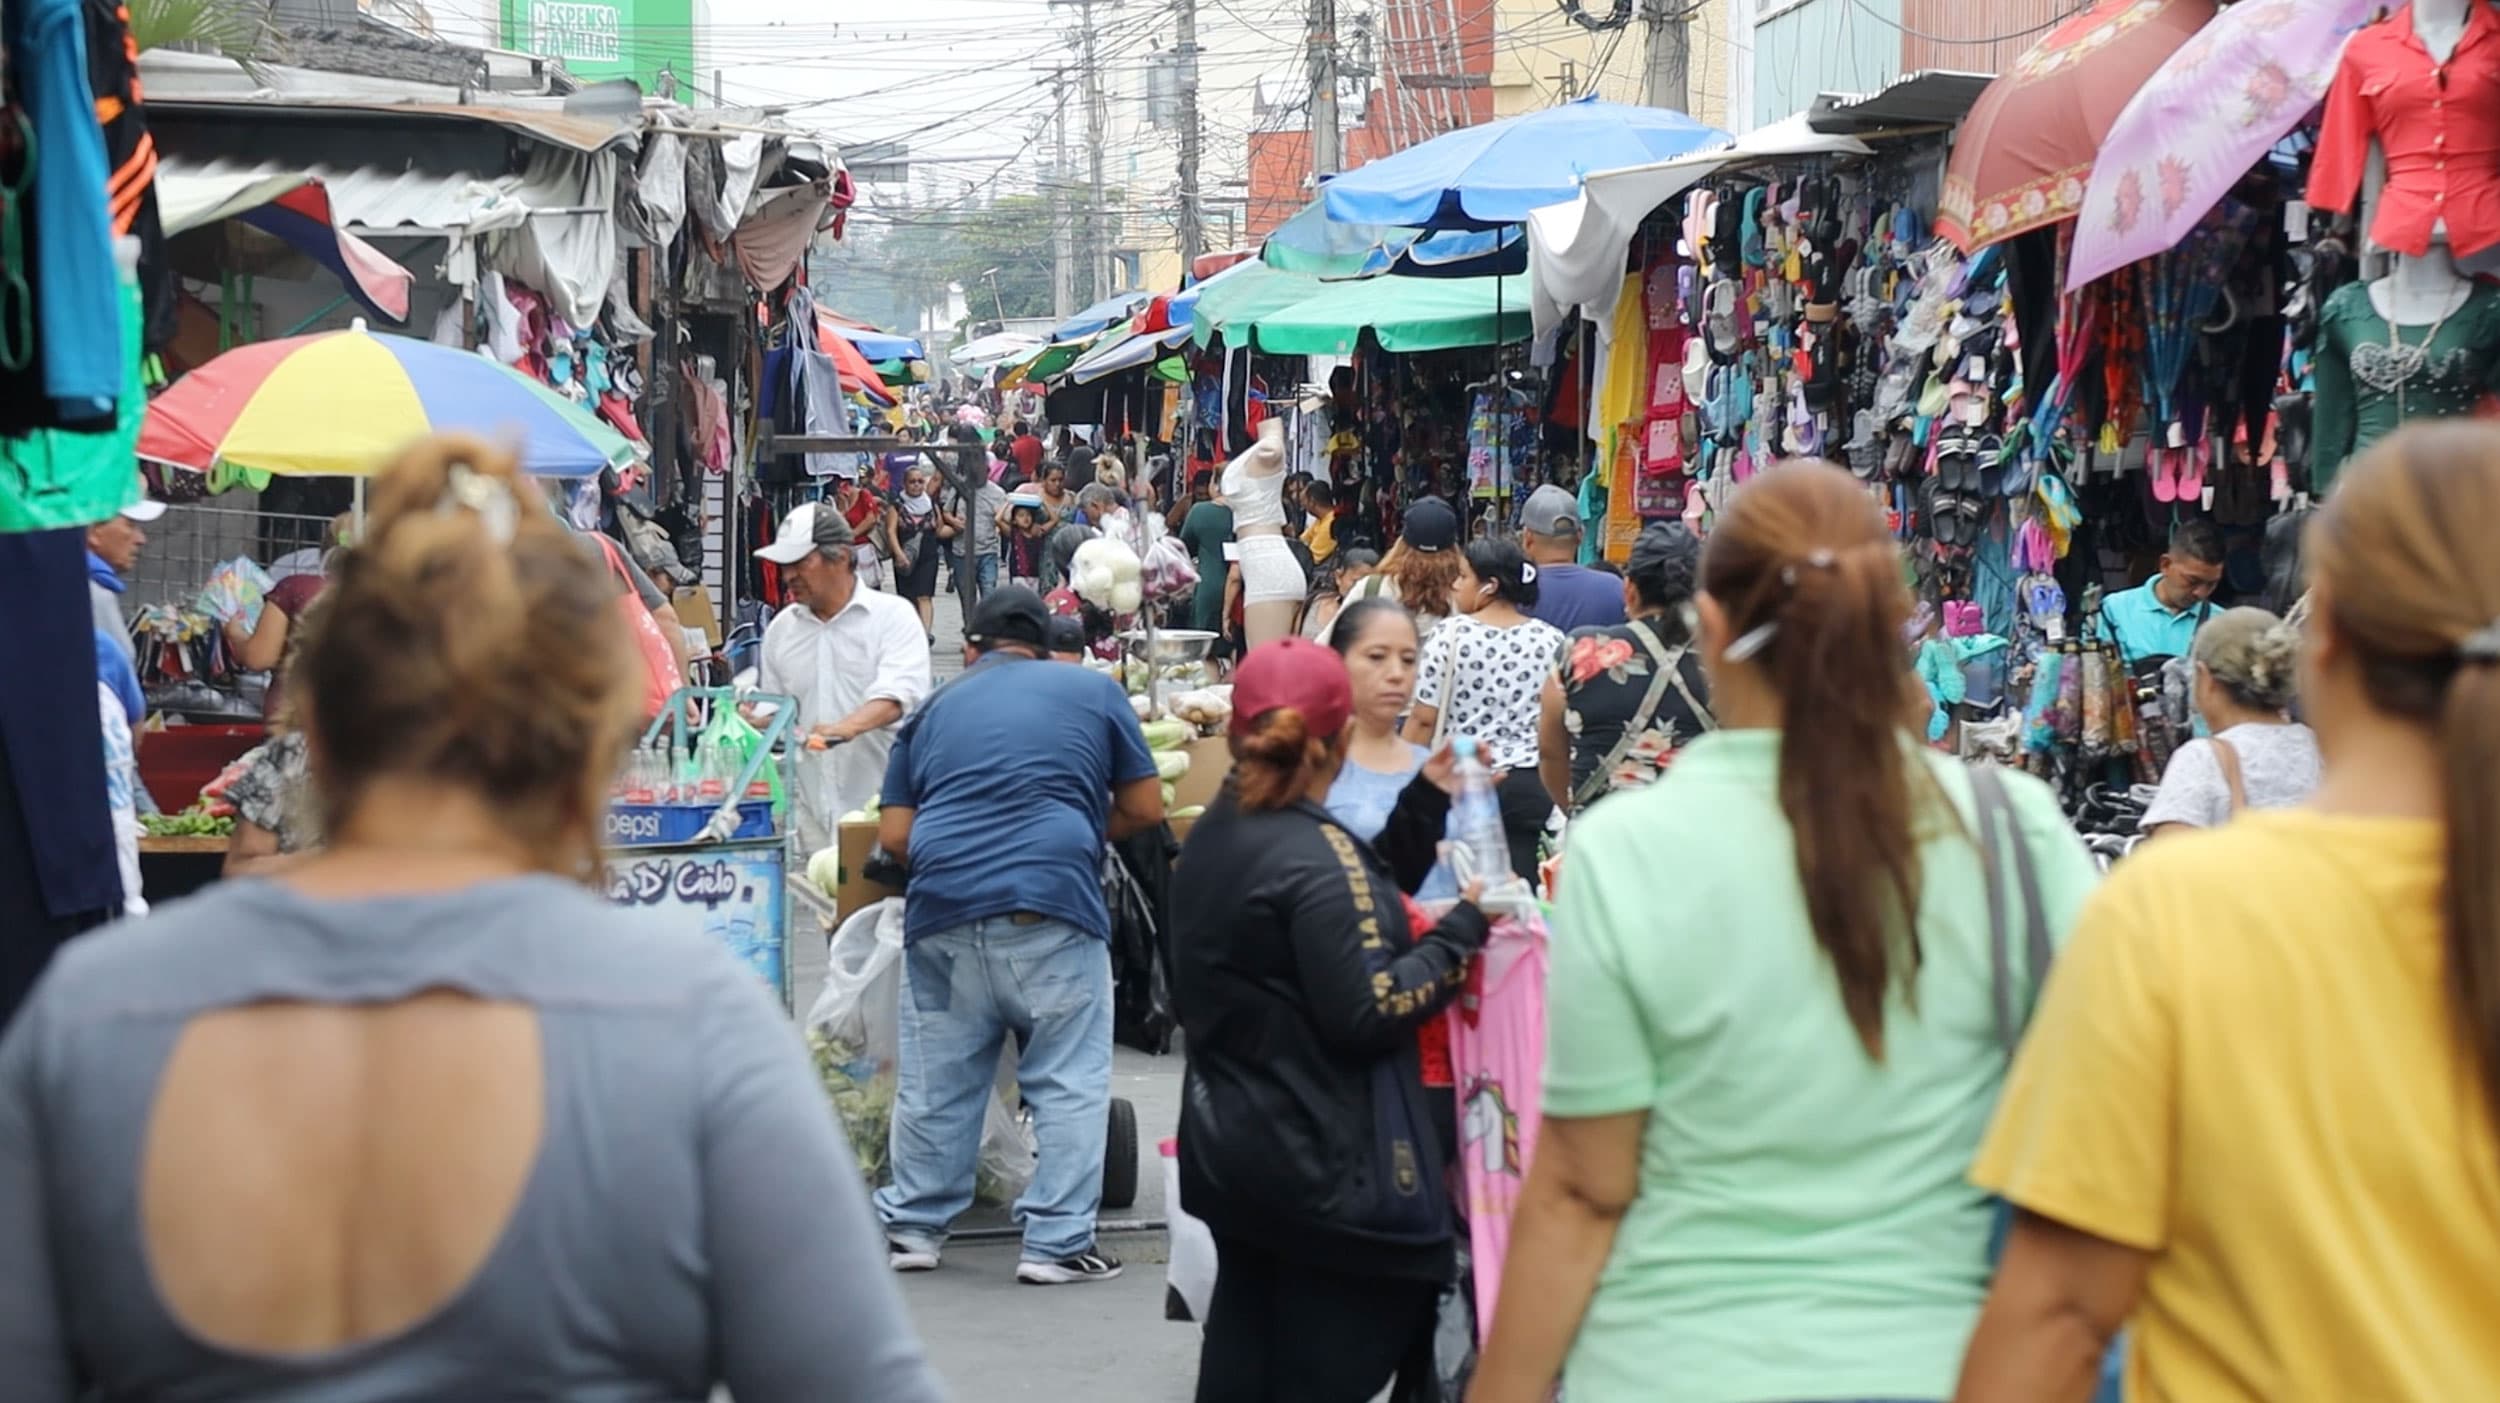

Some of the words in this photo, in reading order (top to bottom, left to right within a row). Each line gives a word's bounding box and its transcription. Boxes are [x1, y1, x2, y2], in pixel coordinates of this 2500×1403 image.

[532, 1, 617, 33] DESPENSA
[532, 31, 618, 59] FAMILIAR
[605, 811, 662, 842] pepsi
[675, 860, 736, 902] Cielo
